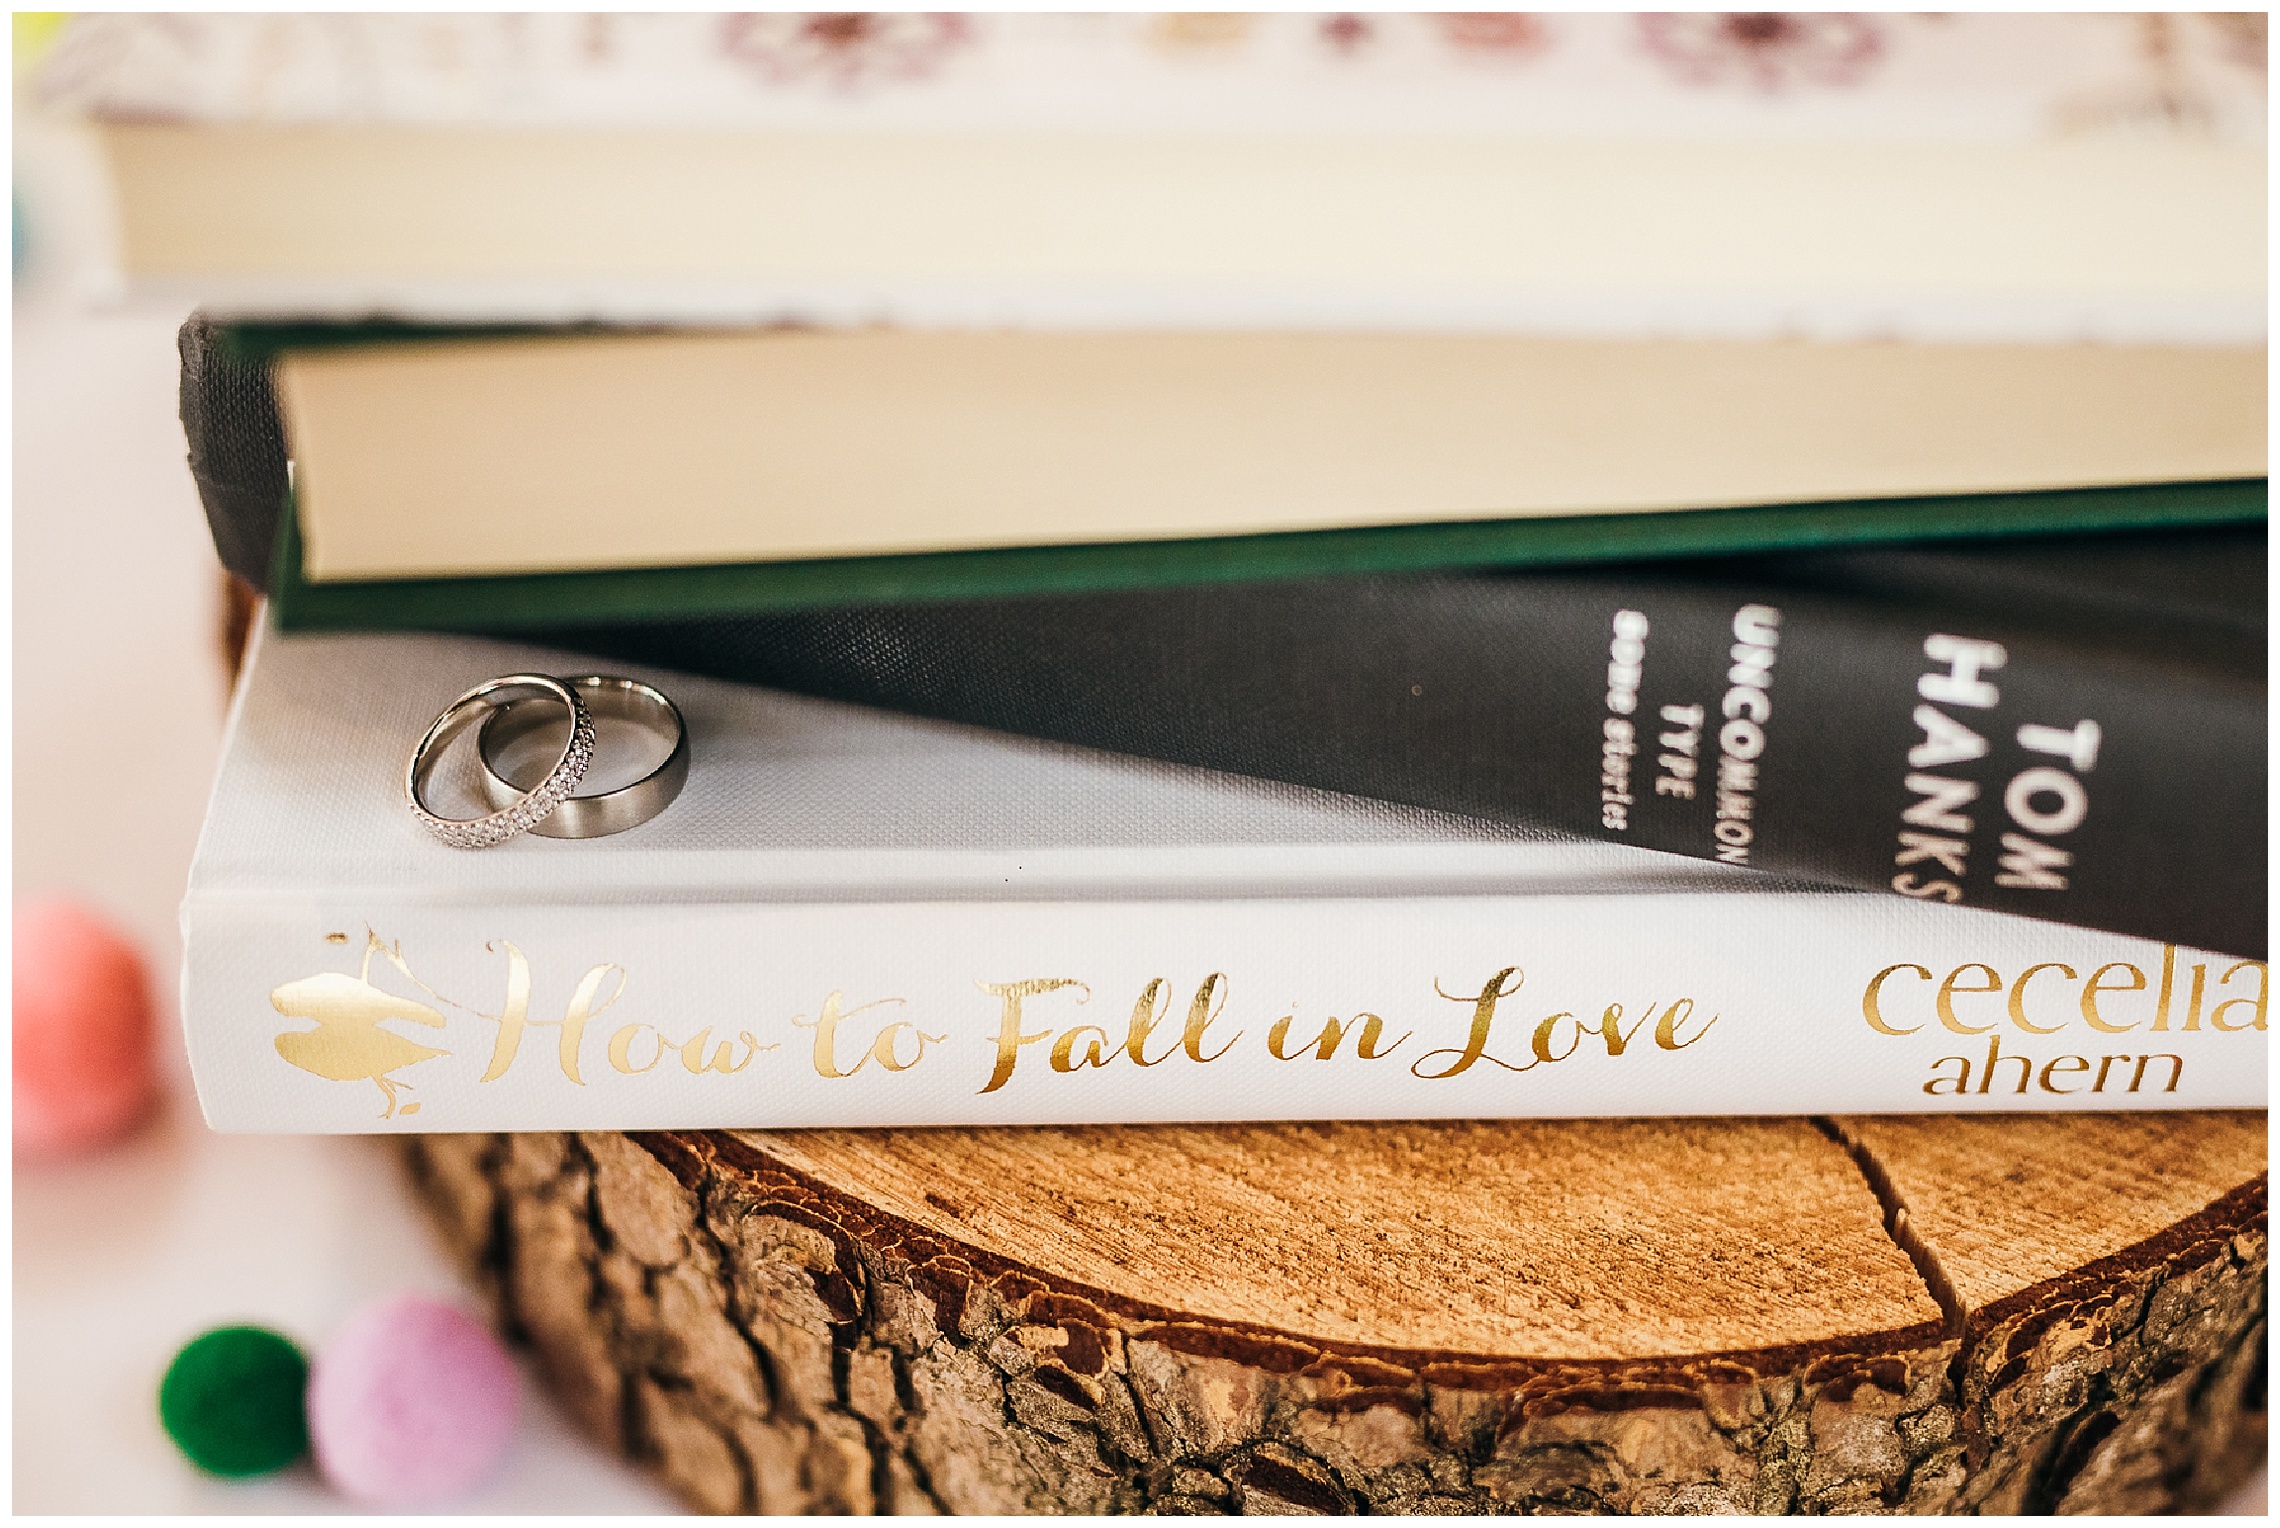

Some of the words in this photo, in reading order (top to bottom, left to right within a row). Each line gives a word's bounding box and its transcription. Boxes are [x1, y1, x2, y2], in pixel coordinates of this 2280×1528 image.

[1601, 717, 1638, 831] stories
[1655, 703, 1704, 800] TYPE
[1714, 604, 1782, 866] UNCOMMON
[1891, 633, 2008, 903] HANKS
[1994, 718, 2103, 890] TOM
[479, 939, 782, 1086] How
[792, 990, 949, 1079] to
[974, 971, 1245, 1095] Fall
[1266, 1000, 1414, 1061] in
[1410, 965, 1721, 1079] Love
[1862, 944, 2268, 1036] cecelia
[1922, 1034, 2184, 1096] ahern
